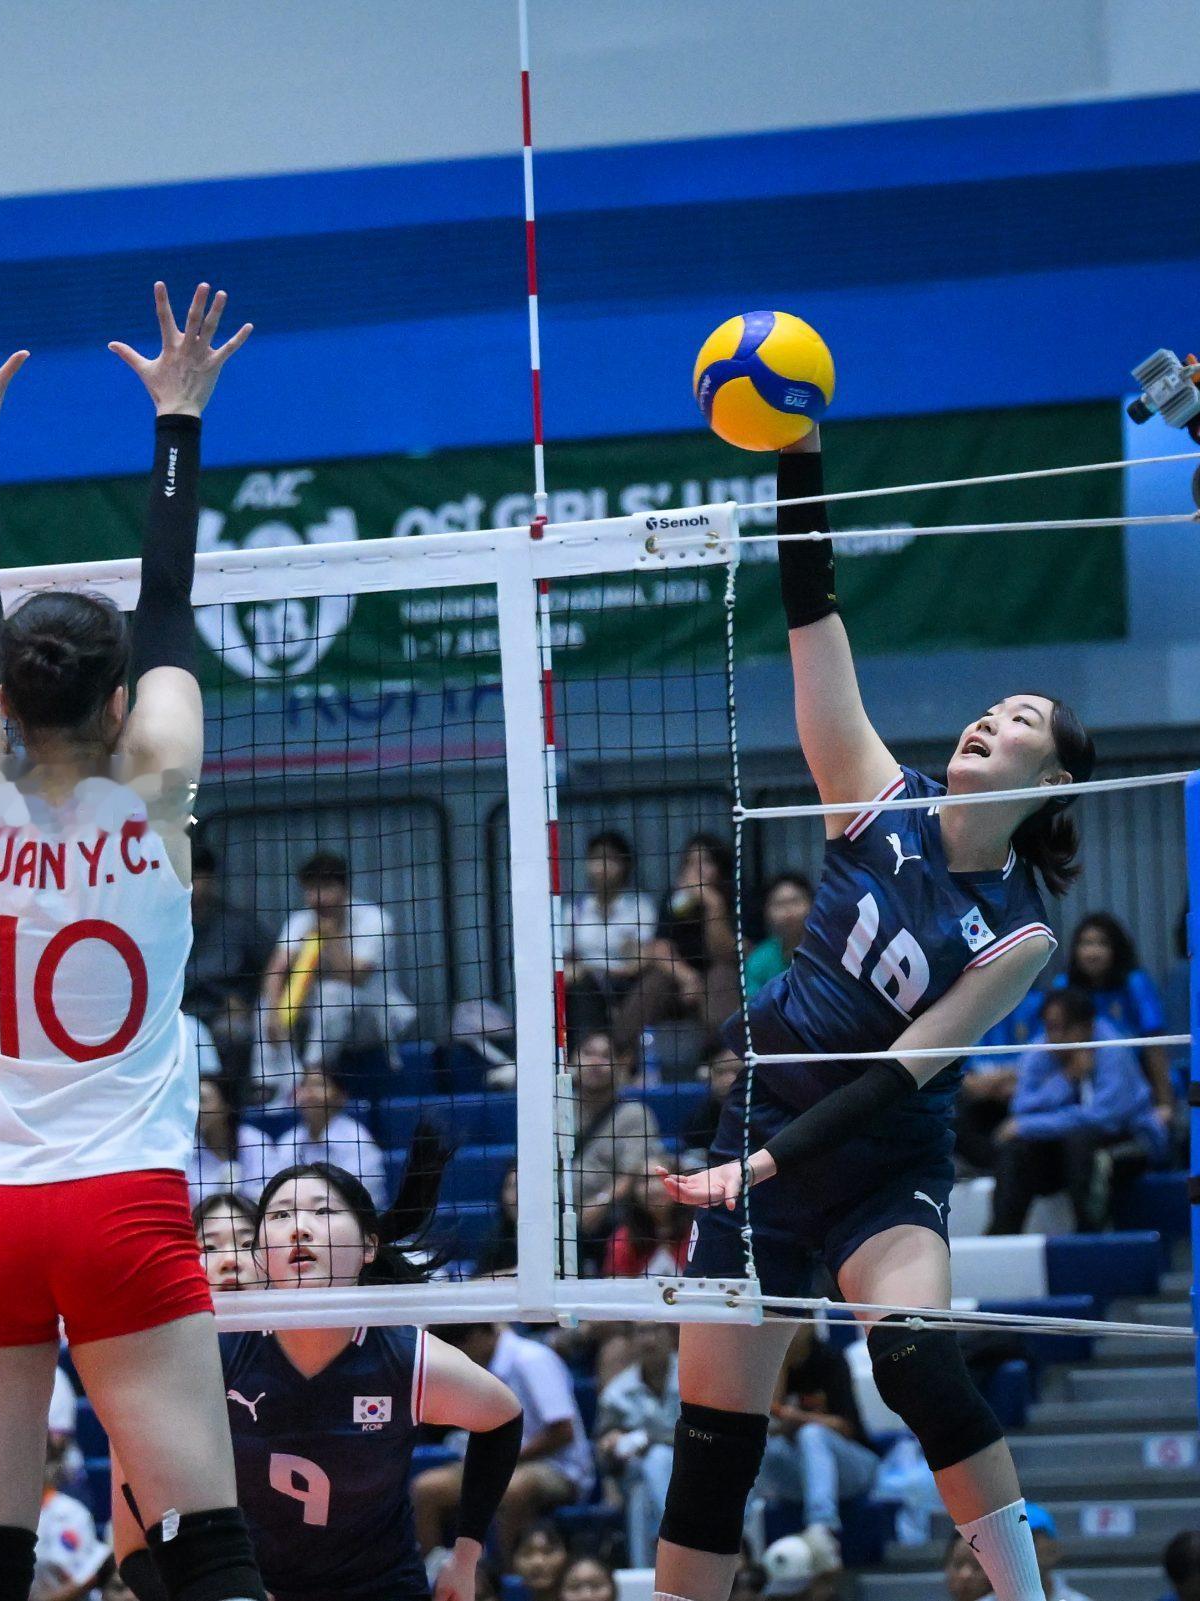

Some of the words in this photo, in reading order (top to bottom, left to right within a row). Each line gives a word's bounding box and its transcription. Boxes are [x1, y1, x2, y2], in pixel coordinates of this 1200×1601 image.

[660, 515, 710, 529] Senoh
[77, 819, 160, 888] Y.C.
[362, 1423, 384, 1432] KOR
[269, 1452, 331, 1527] 9
